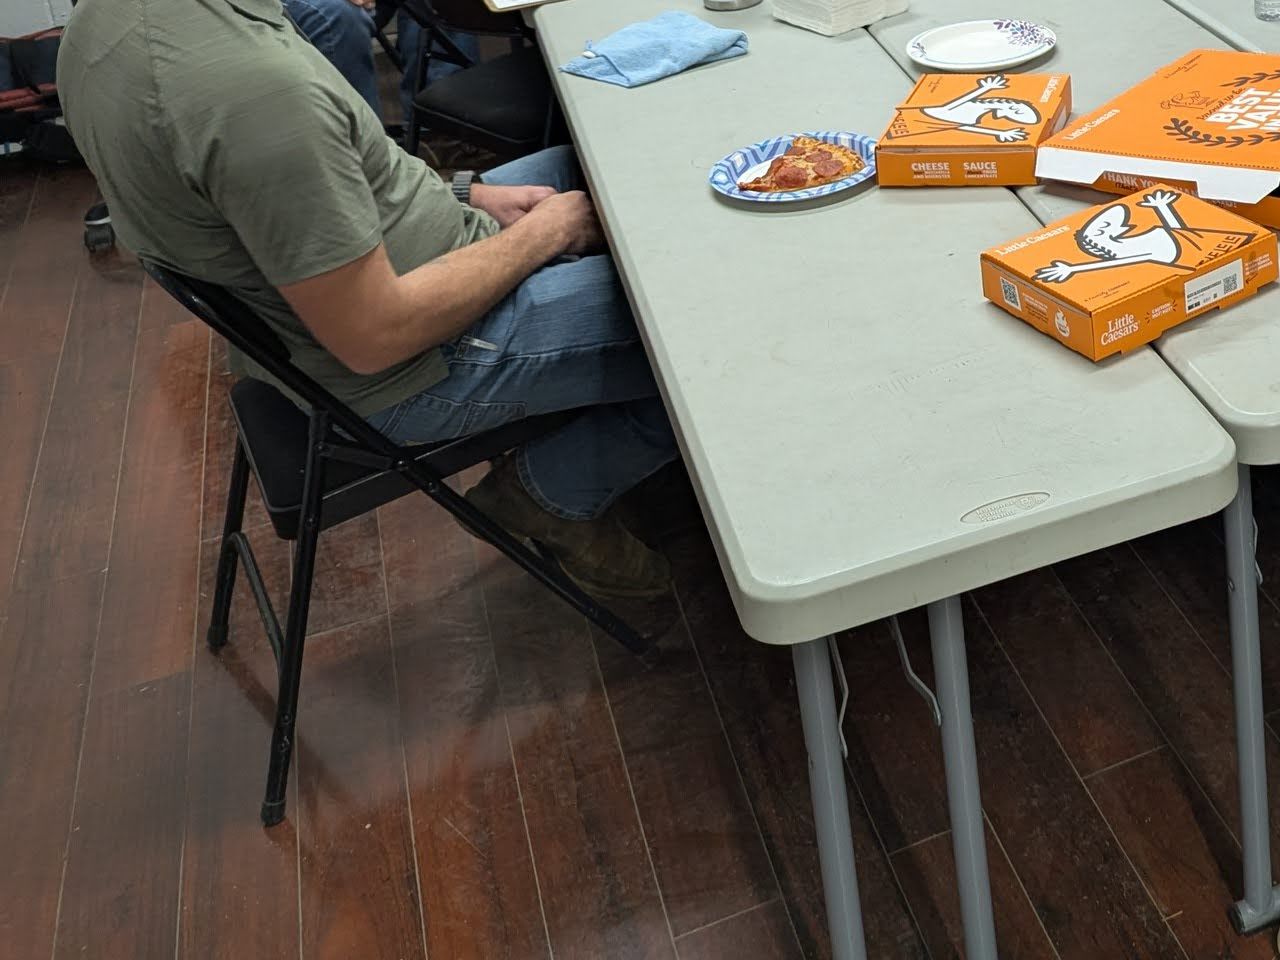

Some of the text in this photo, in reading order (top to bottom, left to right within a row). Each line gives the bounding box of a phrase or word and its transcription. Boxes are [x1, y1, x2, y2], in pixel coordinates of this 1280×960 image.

[1206, 87, 1272, 123] BEST
[911, 162, 950, 171] CHEESE
[963, 161, 997, 170] SAUCE
[1102, 172, 1138, 187] THANK
[996, 225, 1071, 256] Little Caesars
[1108, 313, 1135, 333] Little
[1100, 321, 1139, 346] Caesars
